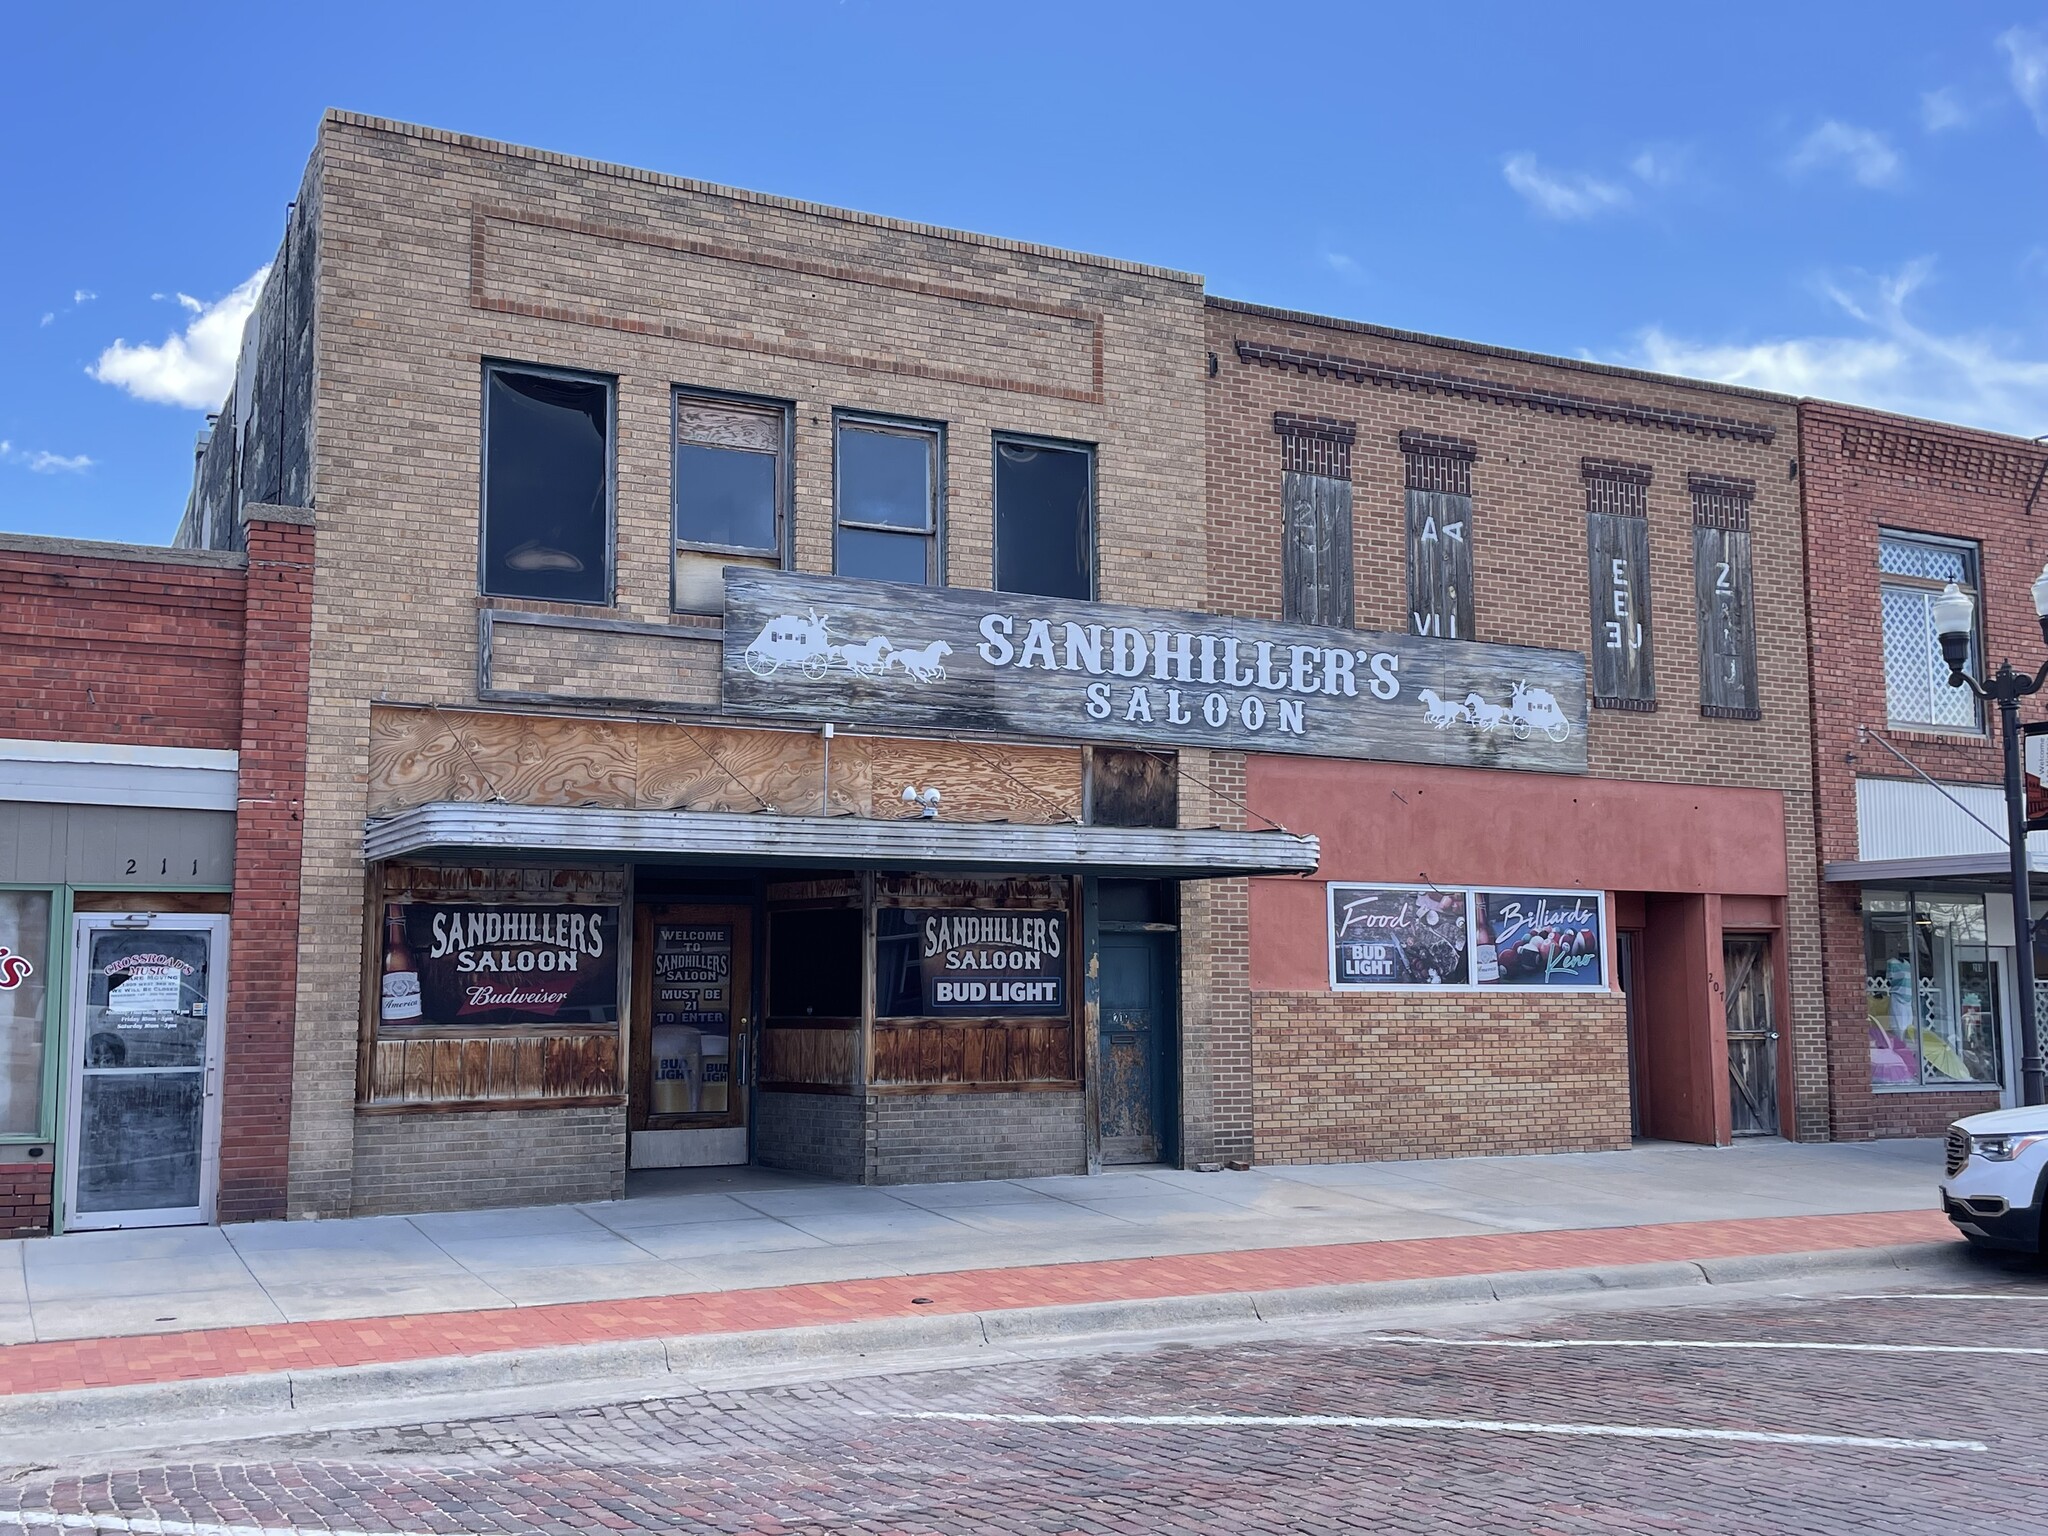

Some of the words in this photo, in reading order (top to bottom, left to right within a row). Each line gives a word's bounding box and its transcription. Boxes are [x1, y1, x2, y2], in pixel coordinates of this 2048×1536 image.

[976, 614, 1400, 700] SANDHILLER'S
[1085, 682, 1307, 735] SALOON
[125, 858, 198, 876] 211
[1336, 896, 1412, 938] Food
[1496, 898, 1594, 943] Billiards
[430, 911, 604, 959] SANDHILLERS
[660, 931, 725, 942] WELCOME
[924, 916, 1061, 959] SANDHILLERS
[684, 943, 701, 953] TO
[1352, 944, 1386, 961] BUD
[104, 953, 195, 977] CROSSROAD'S
[456, 951, 579, 973] SALOON
[655, 955, 728, 975] SANDHILLERS
[945, 950, 1042, 970] SALOON
[1346, 959, 1394, 976] LIGHT
[1543, 944, 1596, 984] Keno
[128, 966, 169, 976] MUSIC
[666, 971, 718, 981] SALOON
[465, 985, 568, 1007] Budweiser
[661, 990, 699, 1000] MUST
[705, 990, 721, 1000] BE
[936, 982, 987, 1002] BUD
[989, 982, 1057, 1002] LIGHT
[384, 999, 418, 1009] America
[684, 1001, 697, 1011] 21
[657, 1013, 675, 1022] TO
[681, 1013, 723, 1023] ENTER
[661, 1058, 689, 1070] BUD
[706, 1063, 728, 1072] BUD
[702, 1073, 727, 1082] LIGH
